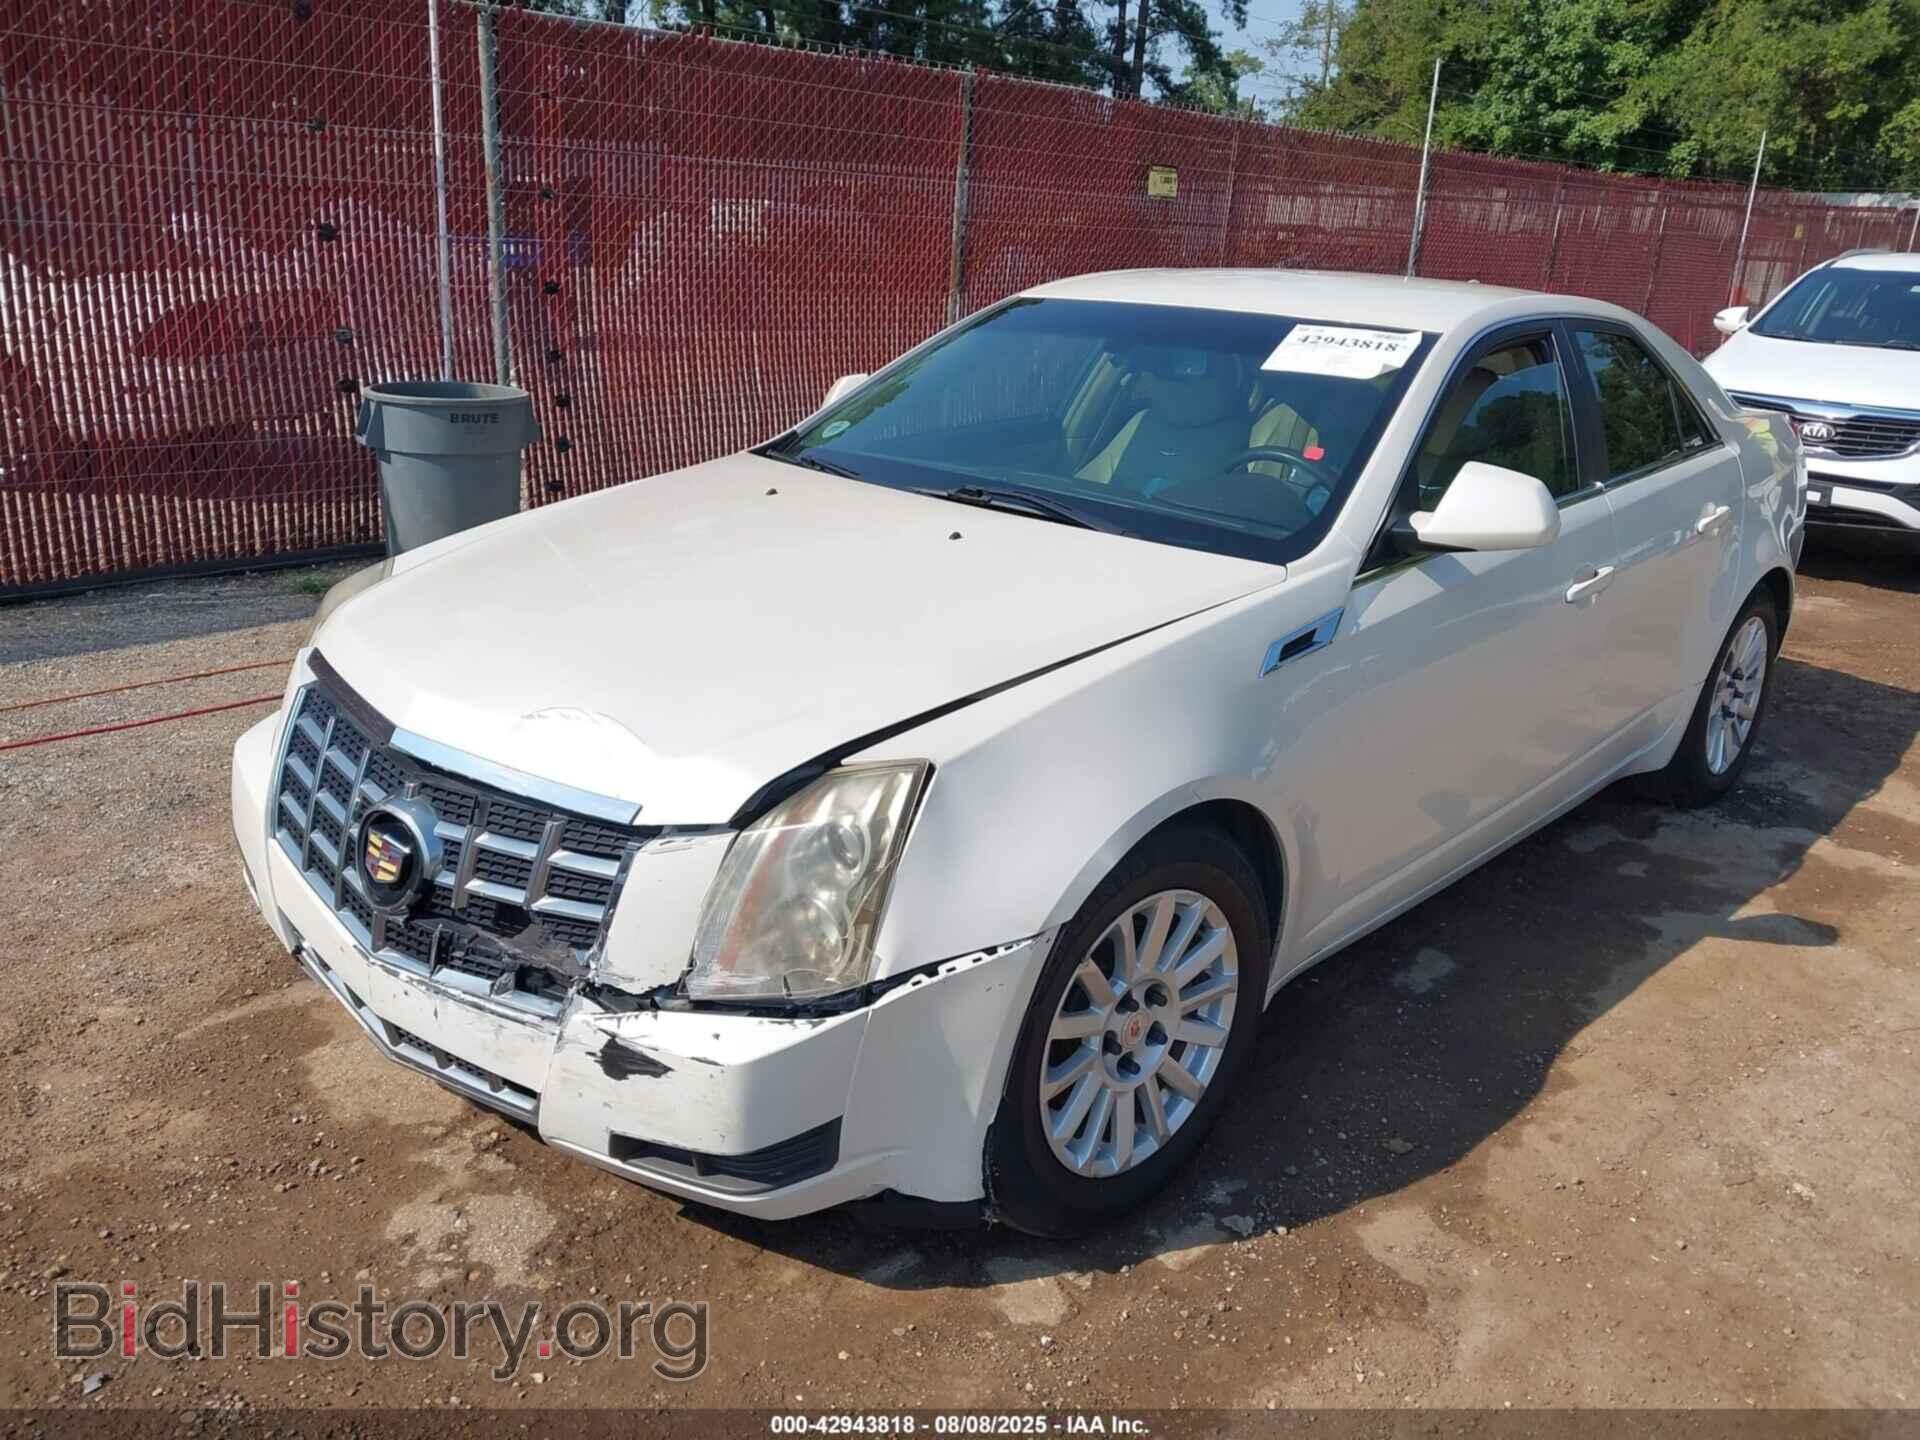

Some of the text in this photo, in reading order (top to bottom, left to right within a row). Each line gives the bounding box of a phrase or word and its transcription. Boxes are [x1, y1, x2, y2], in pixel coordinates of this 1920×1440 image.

[1297, 334, 1398, 352] 42943818
[450, 413, 500, 424] BRUTE
[1802, 424, 1828, 438] KIA
